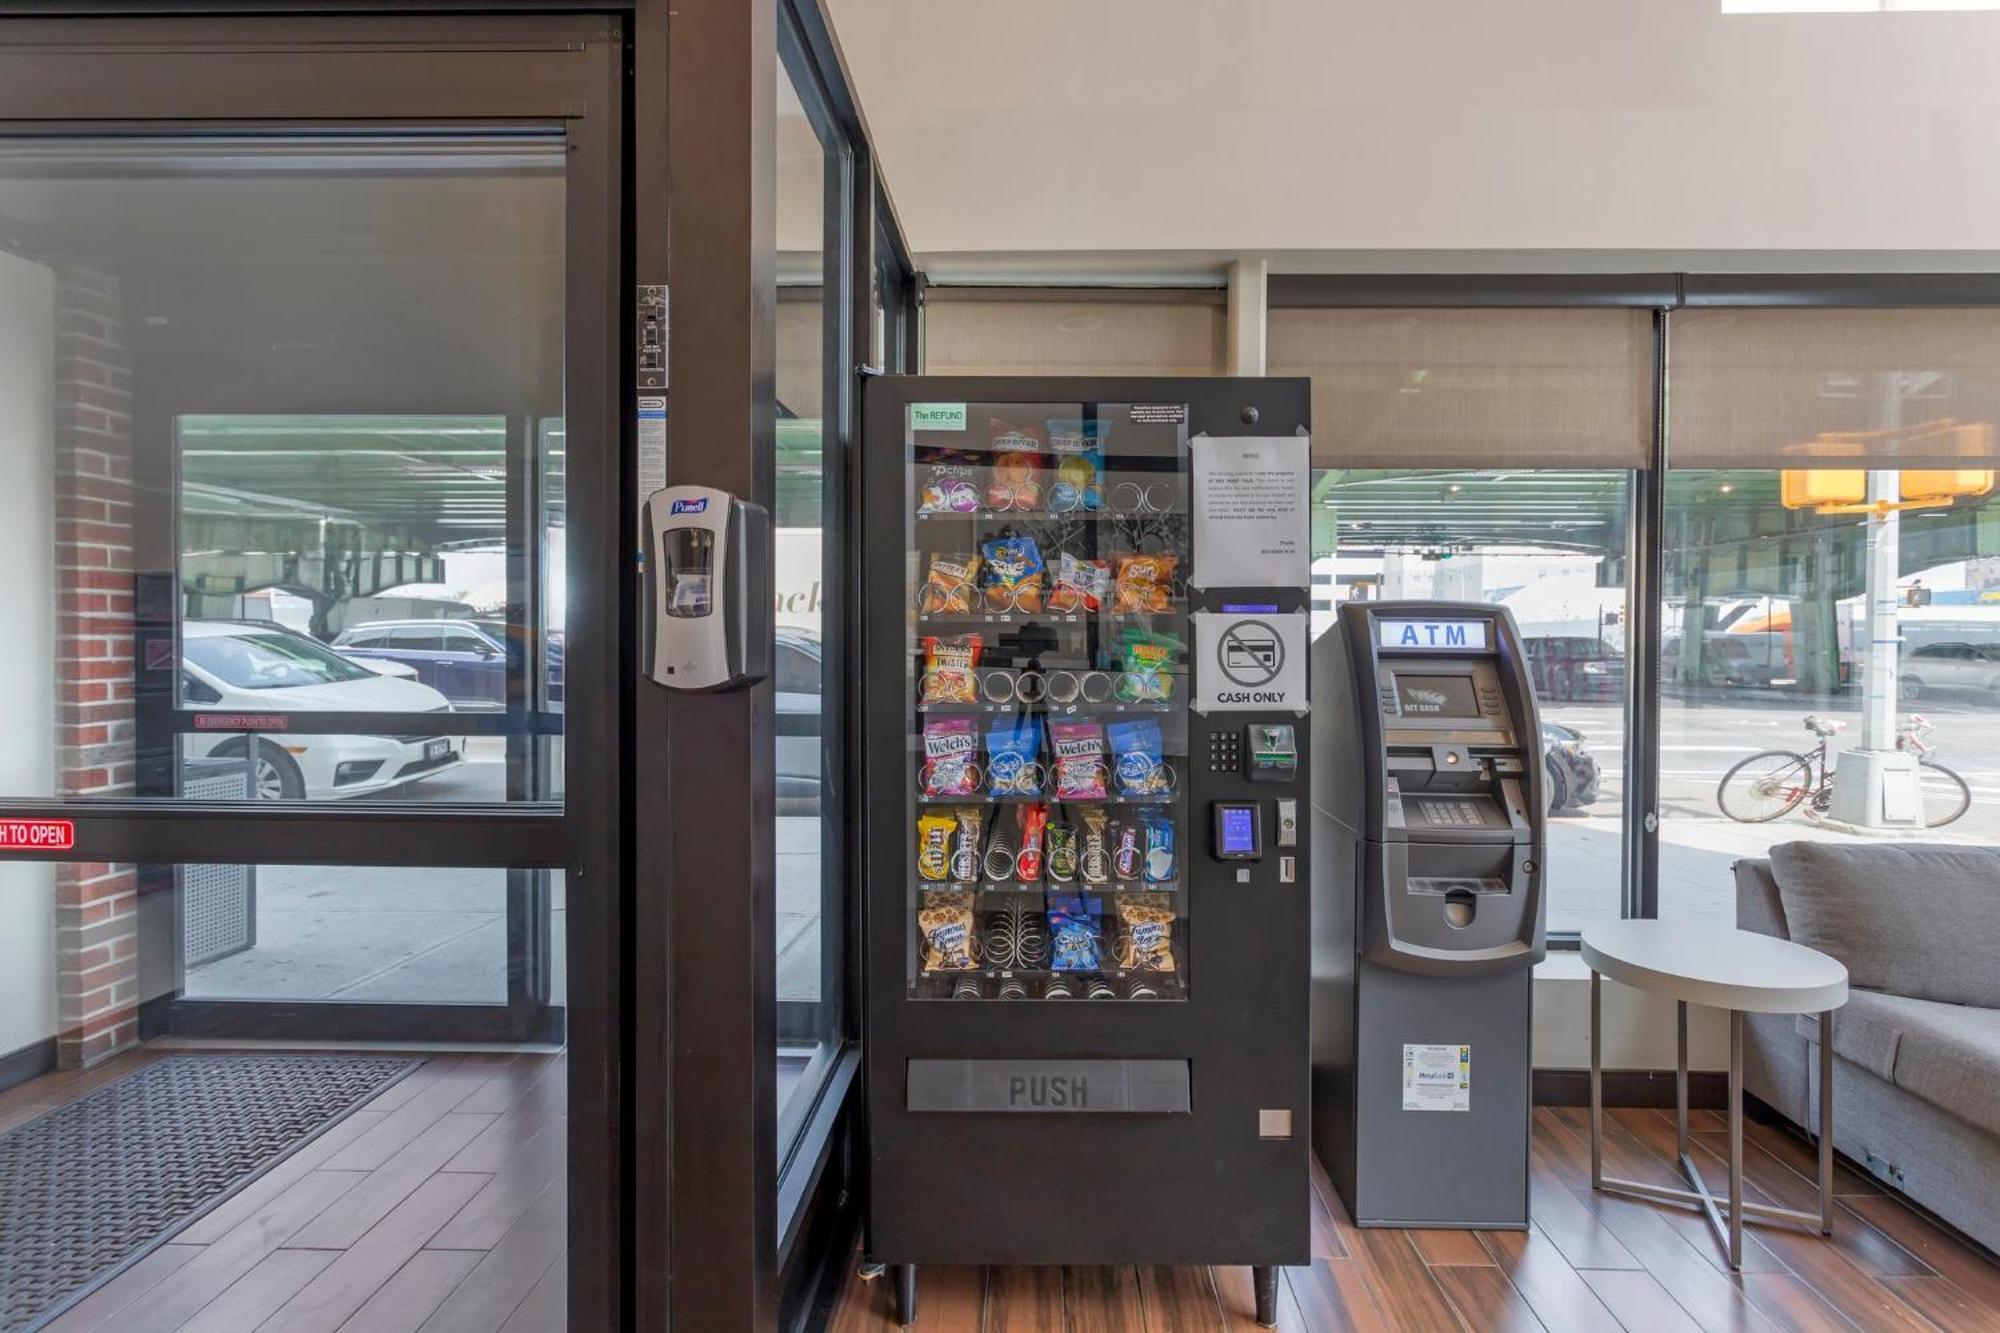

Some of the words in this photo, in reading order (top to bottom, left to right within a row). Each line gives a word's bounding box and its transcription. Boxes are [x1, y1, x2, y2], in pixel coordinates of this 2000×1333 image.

[914, 411, 929, 420] The
[930, 411, 963, 420] REFUND
[1400, 624, 1466, 646] ATM
[1217, 692, 1250, 703] CASH
[1252, 692, 1286, 703] ONLY
[927, 736, 971, 754] Welch's
[1058, 740, 1103, 755] Welch's
[9, 824, 28, 844] TO
[30, 825, 65, 844] OPEN
[1009, 1076, 1088, 1107] PUSH
